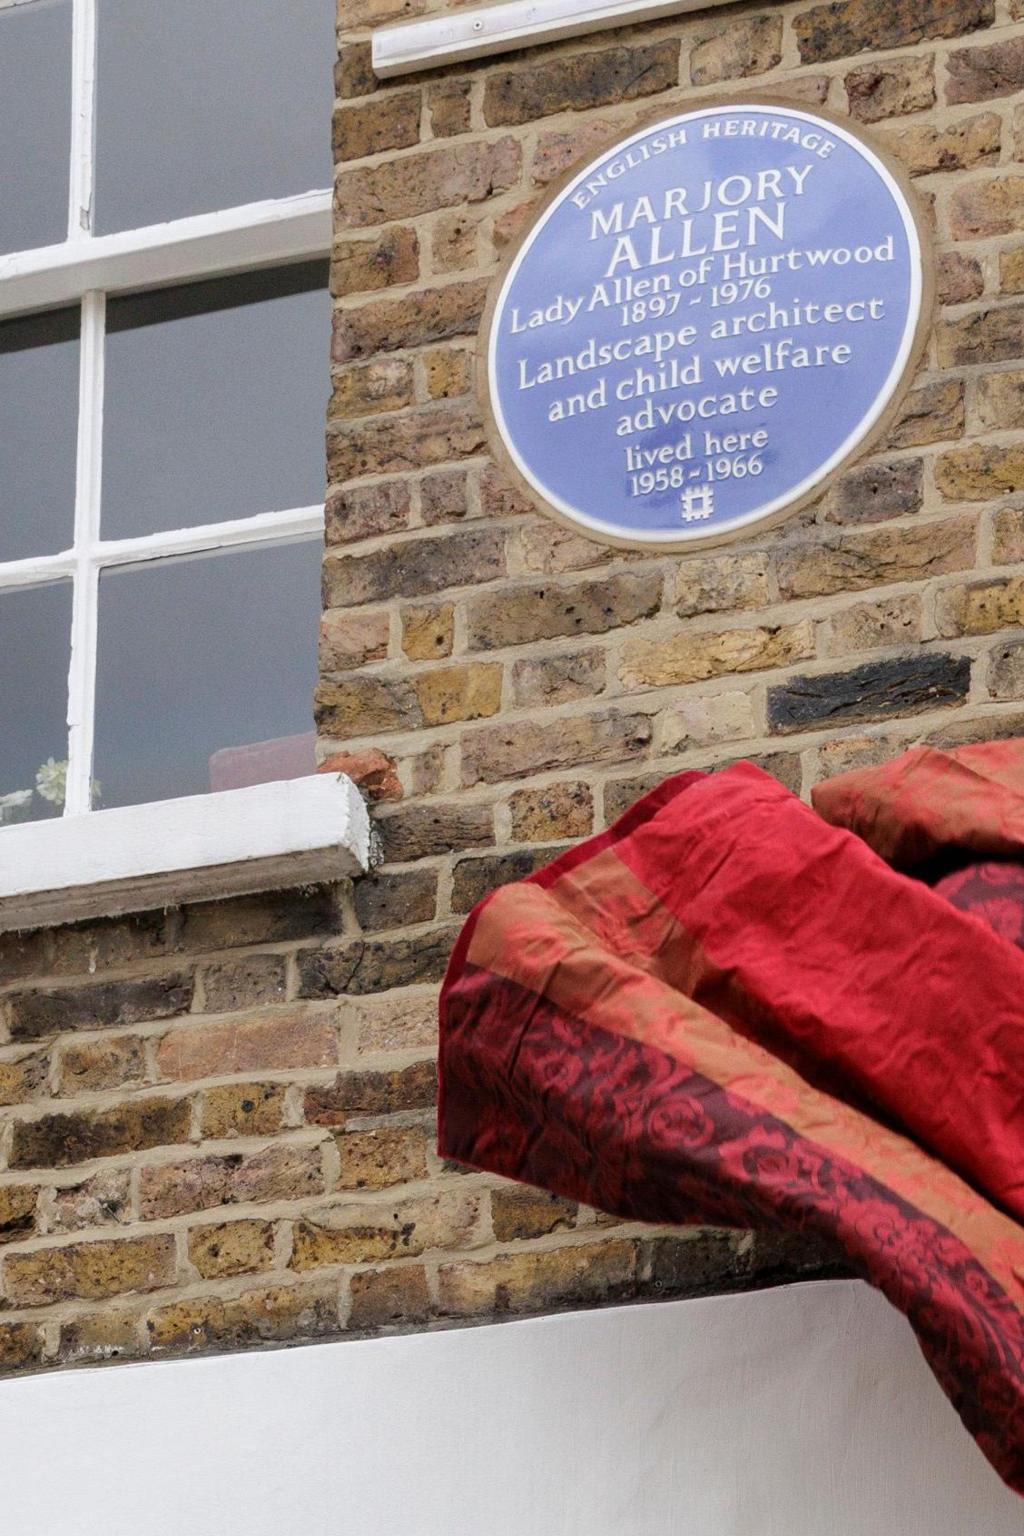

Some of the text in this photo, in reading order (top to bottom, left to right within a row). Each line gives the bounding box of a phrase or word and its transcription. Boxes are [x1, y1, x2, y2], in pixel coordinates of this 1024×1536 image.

[572, 119, 836, 211] ENGLISH HERITAGE
[589, 164, 813, 240] MARJORY
[605, 203, 786, 277] ALLEN
[510, 235, 895, 334] Lady Allen of Hurtwood
[517, 296, 886, 390] Landscape architect
[547, 338, 852, 423] and child welfare
[615, 383, 779, 437] advocate
[625, 429, 769, 472] lived here
